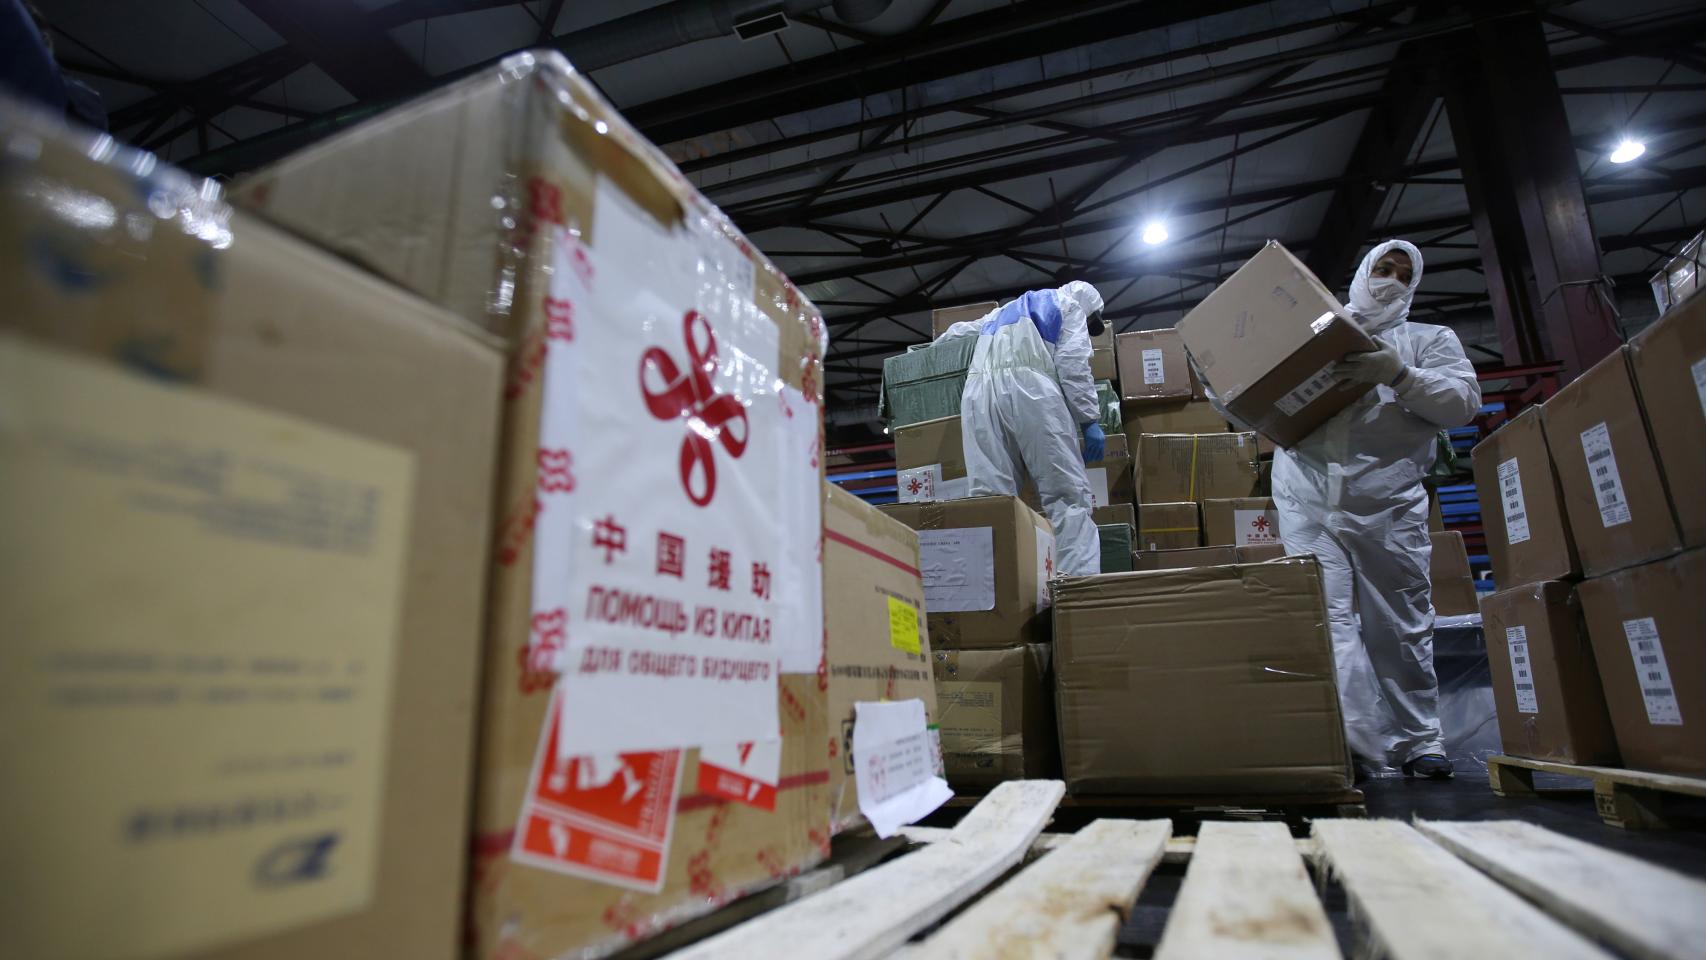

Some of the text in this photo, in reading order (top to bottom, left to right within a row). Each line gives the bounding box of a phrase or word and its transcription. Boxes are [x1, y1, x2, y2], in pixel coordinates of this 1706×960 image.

[585, 586, 771, 644] ПОМОЩЬ ИЗ КИТАЯ
[579, 647, 622, 675] ДЛЯ
[628, 650, 697, 681] ОБЩЕГО
